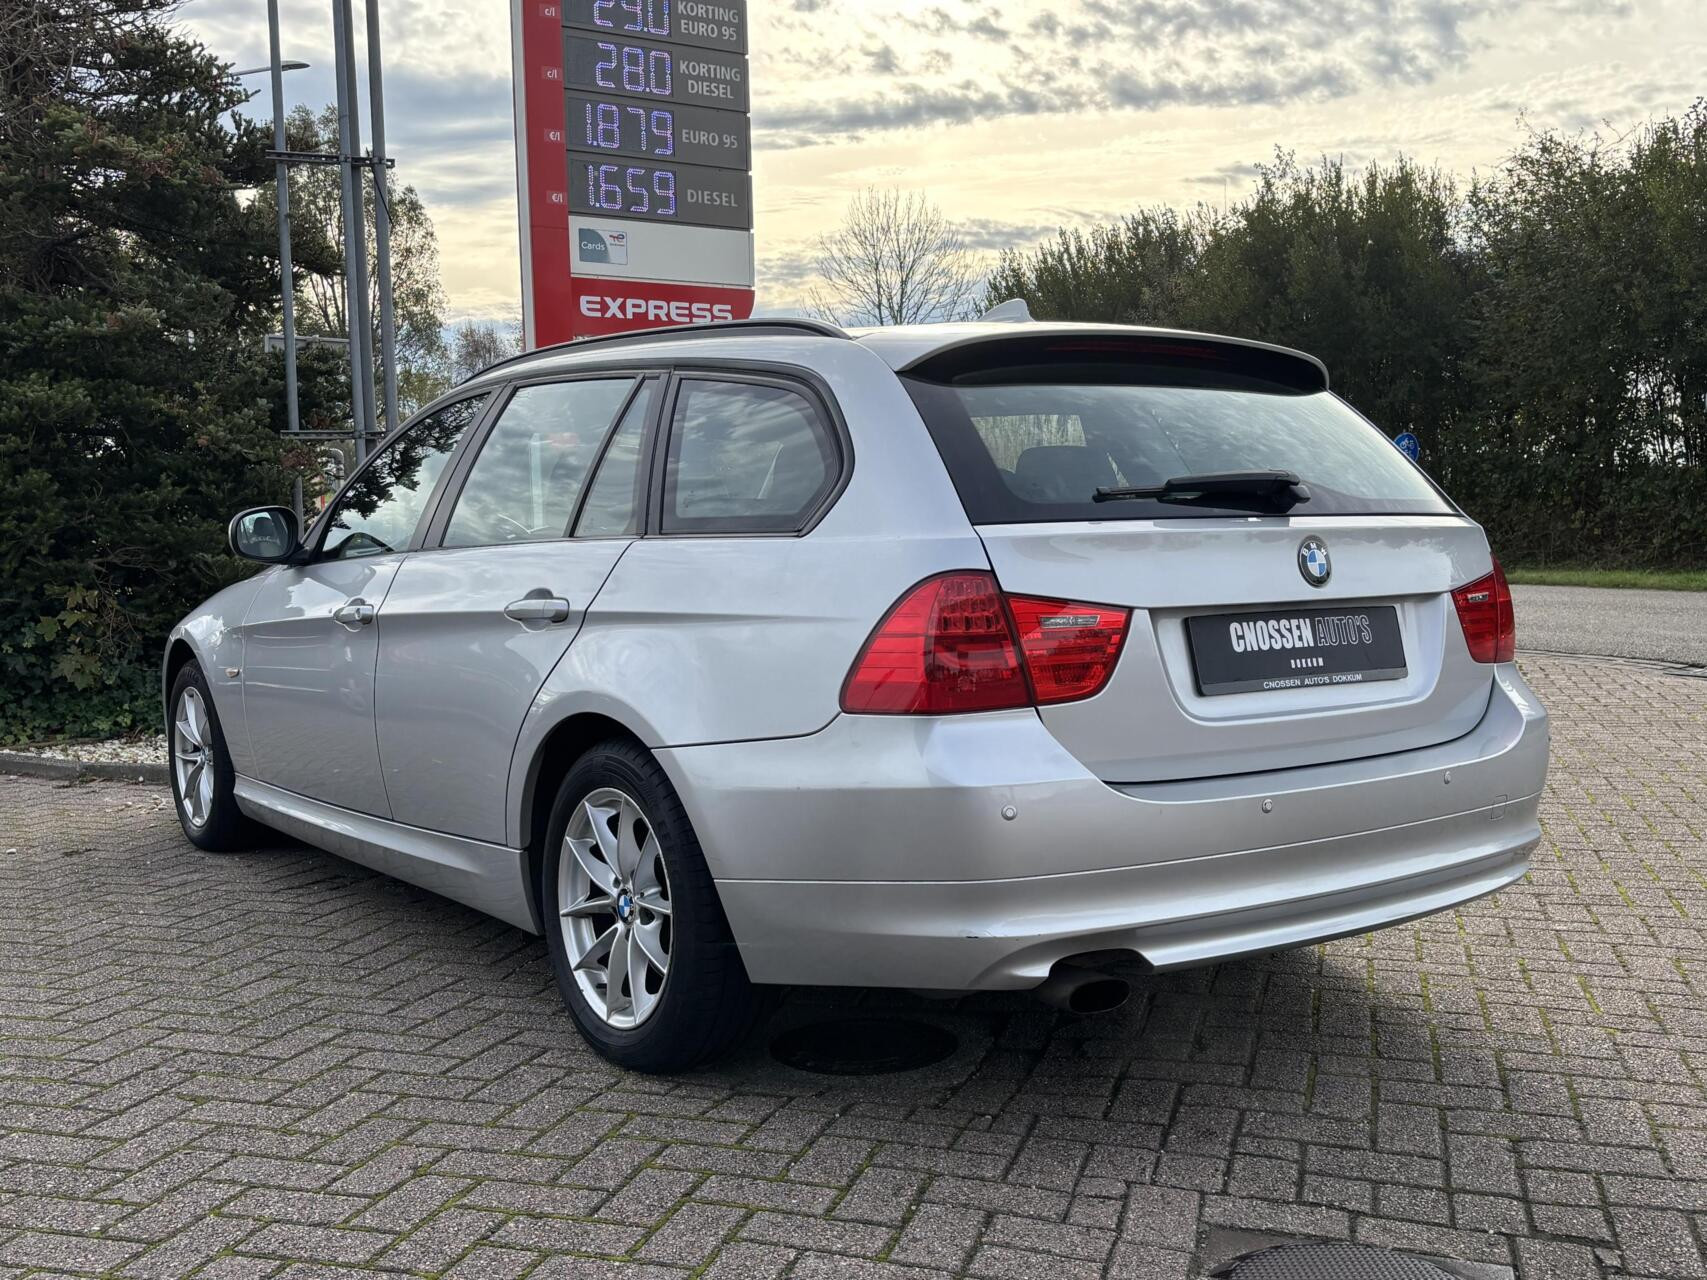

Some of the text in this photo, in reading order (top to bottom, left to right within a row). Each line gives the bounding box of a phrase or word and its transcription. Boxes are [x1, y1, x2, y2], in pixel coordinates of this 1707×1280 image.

[545, 7, 555, 17] c/l
[677, 1, 739, 23] KORTING
[680, 20, 737, 41] EURO 95
[547, 68, 557, 79] c/l
[595, 42, 672, 95] 28.0
[679, 60, 741, 82] KORTING
[688, 80, 735, 99] DIESEL
[586, 103, 673, 155] 1.879
[682, 129, 738, 149] EURO 95
[588, 164, 676, 215] 1.659
[687, 189, 739, 207] DIESEL
[581, 241, 606, 251] Cards
[579, 295, 733, 323] EXPRESS
[1302, 542, 1327, 557] BMW
[1229, 615, 1373, 653] CNOSSEN AUTO'S
[1263, 673, 1363, 689] CNOSSEN AUTO'S DOKKUM
